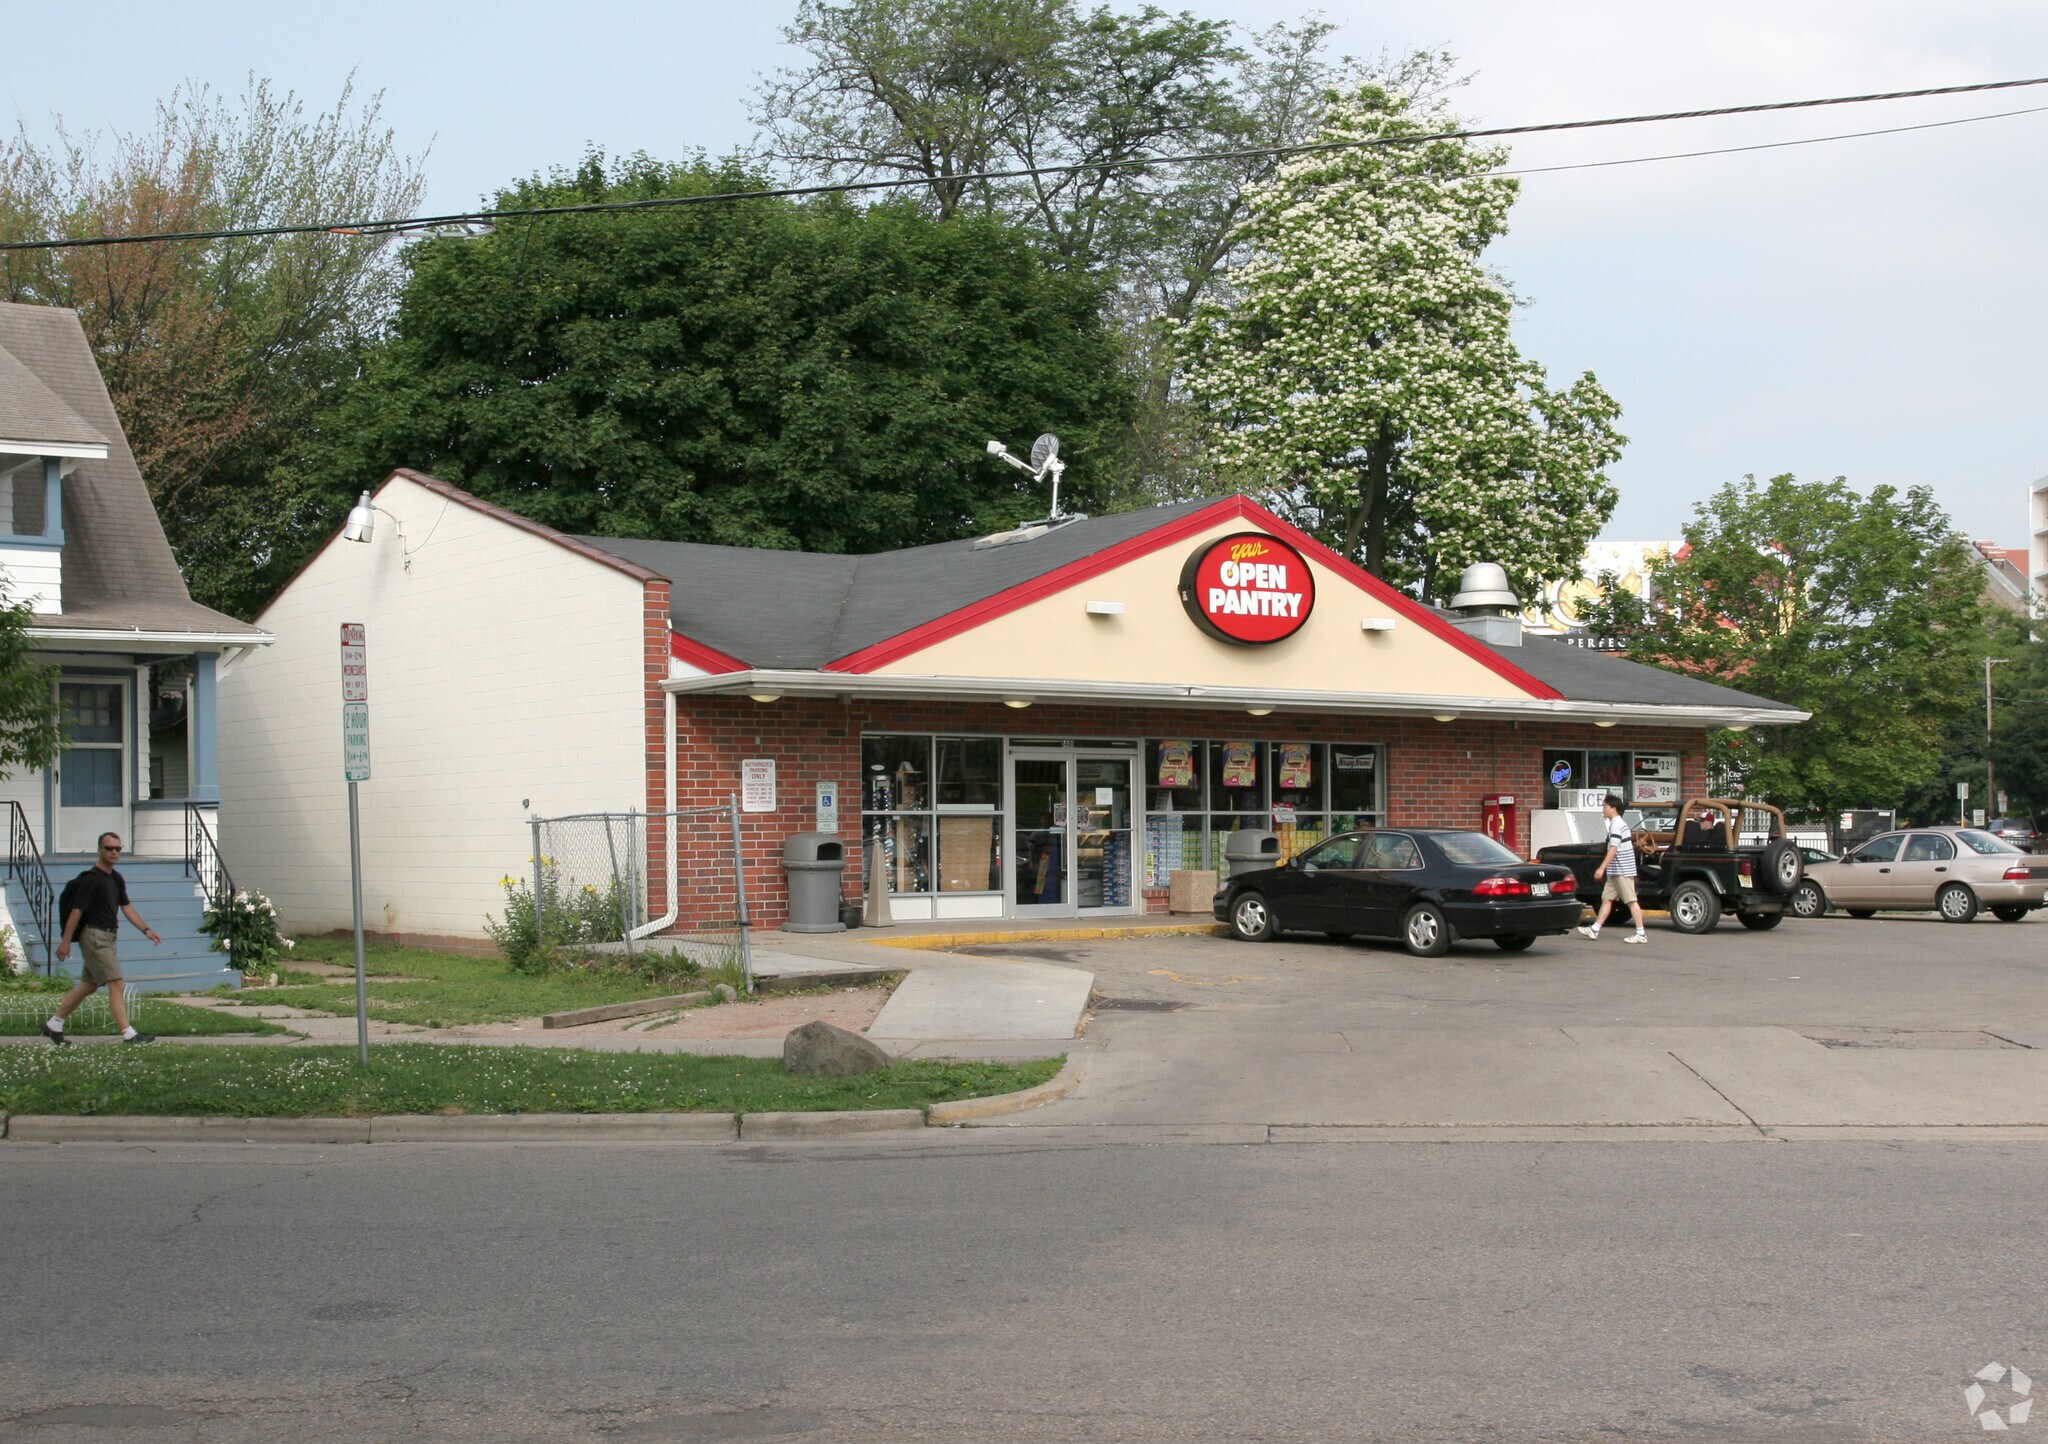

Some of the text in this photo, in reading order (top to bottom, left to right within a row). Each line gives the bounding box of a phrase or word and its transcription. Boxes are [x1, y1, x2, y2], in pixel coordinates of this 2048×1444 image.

[1230, 541, 1269, 577] your
[1220, 560, 1287, 589] OPEN
[1208, 587, 1303, 617] PANTRY
[1567, 637, 1627, 648] PERFEC
[345, 712, 367, 729] 2 HOUR
[347, 734, 366, 747] PARKING
[1591, 766, 1624, 784] ATM
[1582, 793, 1604, 807] ICE
